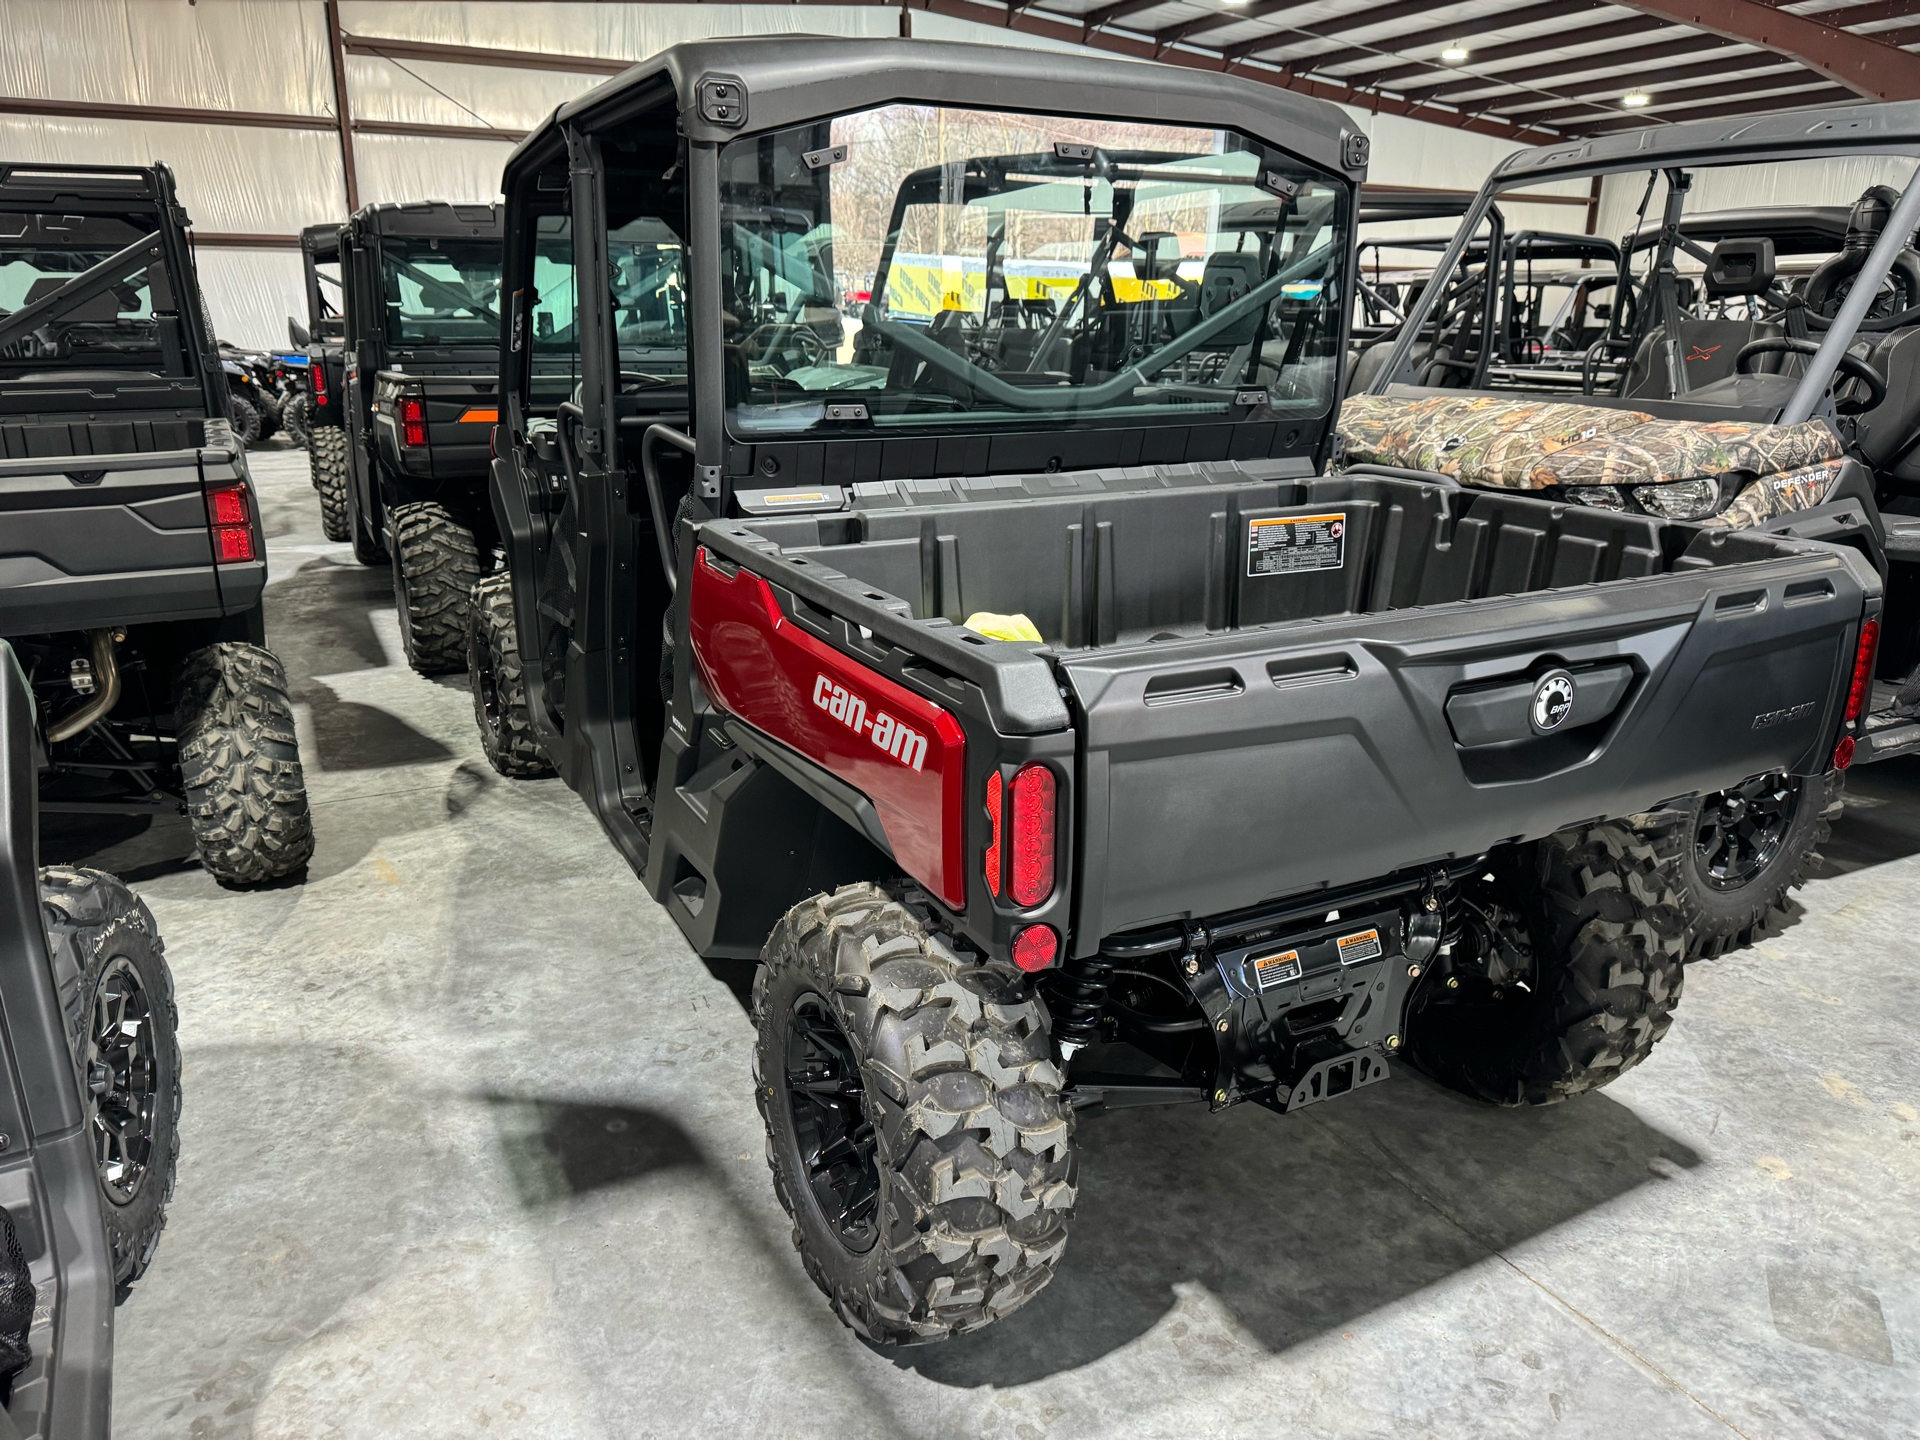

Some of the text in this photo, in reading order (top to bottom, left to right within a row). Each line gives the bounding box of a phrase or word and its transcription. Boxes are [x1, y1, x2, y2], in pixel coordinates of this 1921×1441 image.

[1560, 428, 1597, 446] HD10
[1773, 470, 1829, 490] DEFENDER
[1550, 703, 1570, 715] BRP
[813, 674, 928, 773] can-am
[1349, 933, 1371, 943] WARNING
[1268, 954, 1291, 966] WARNING
